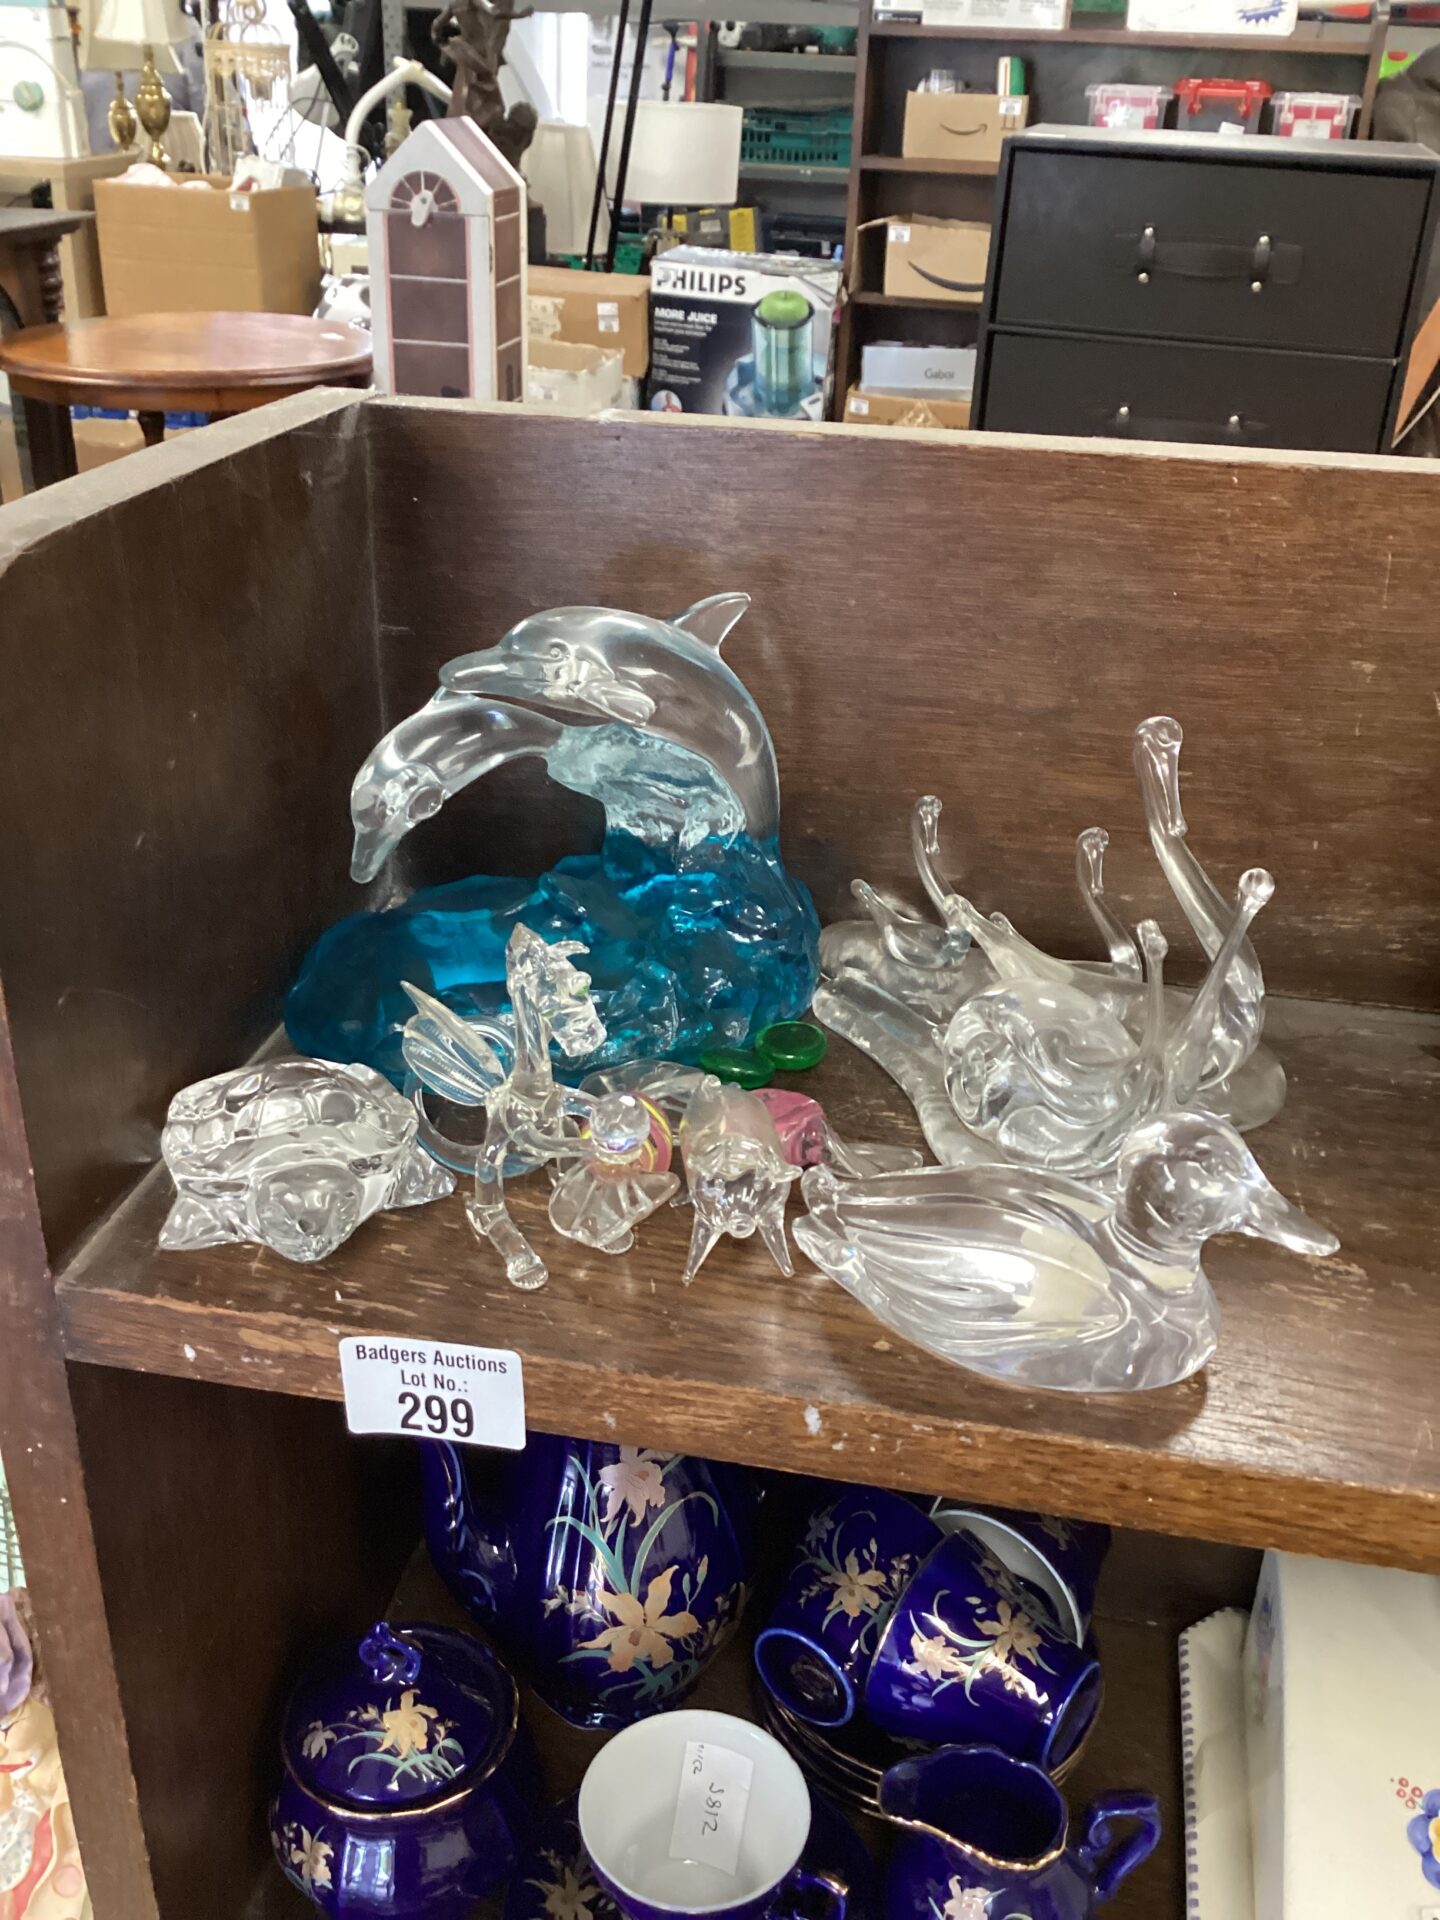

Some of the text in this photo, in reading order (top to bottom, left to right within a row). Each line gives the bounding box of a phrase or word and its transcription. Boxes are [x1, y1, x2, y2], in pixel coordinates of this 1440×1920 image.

[656, 266, 747, 297] PHILIPS
[654, 306, 719, 325] MORE JUICE
[355, 1344, 508, 1374] Badgers Auctions
[400, 1369, 427, 1388] Lot
[398, 1391, 475, 1438] 299
